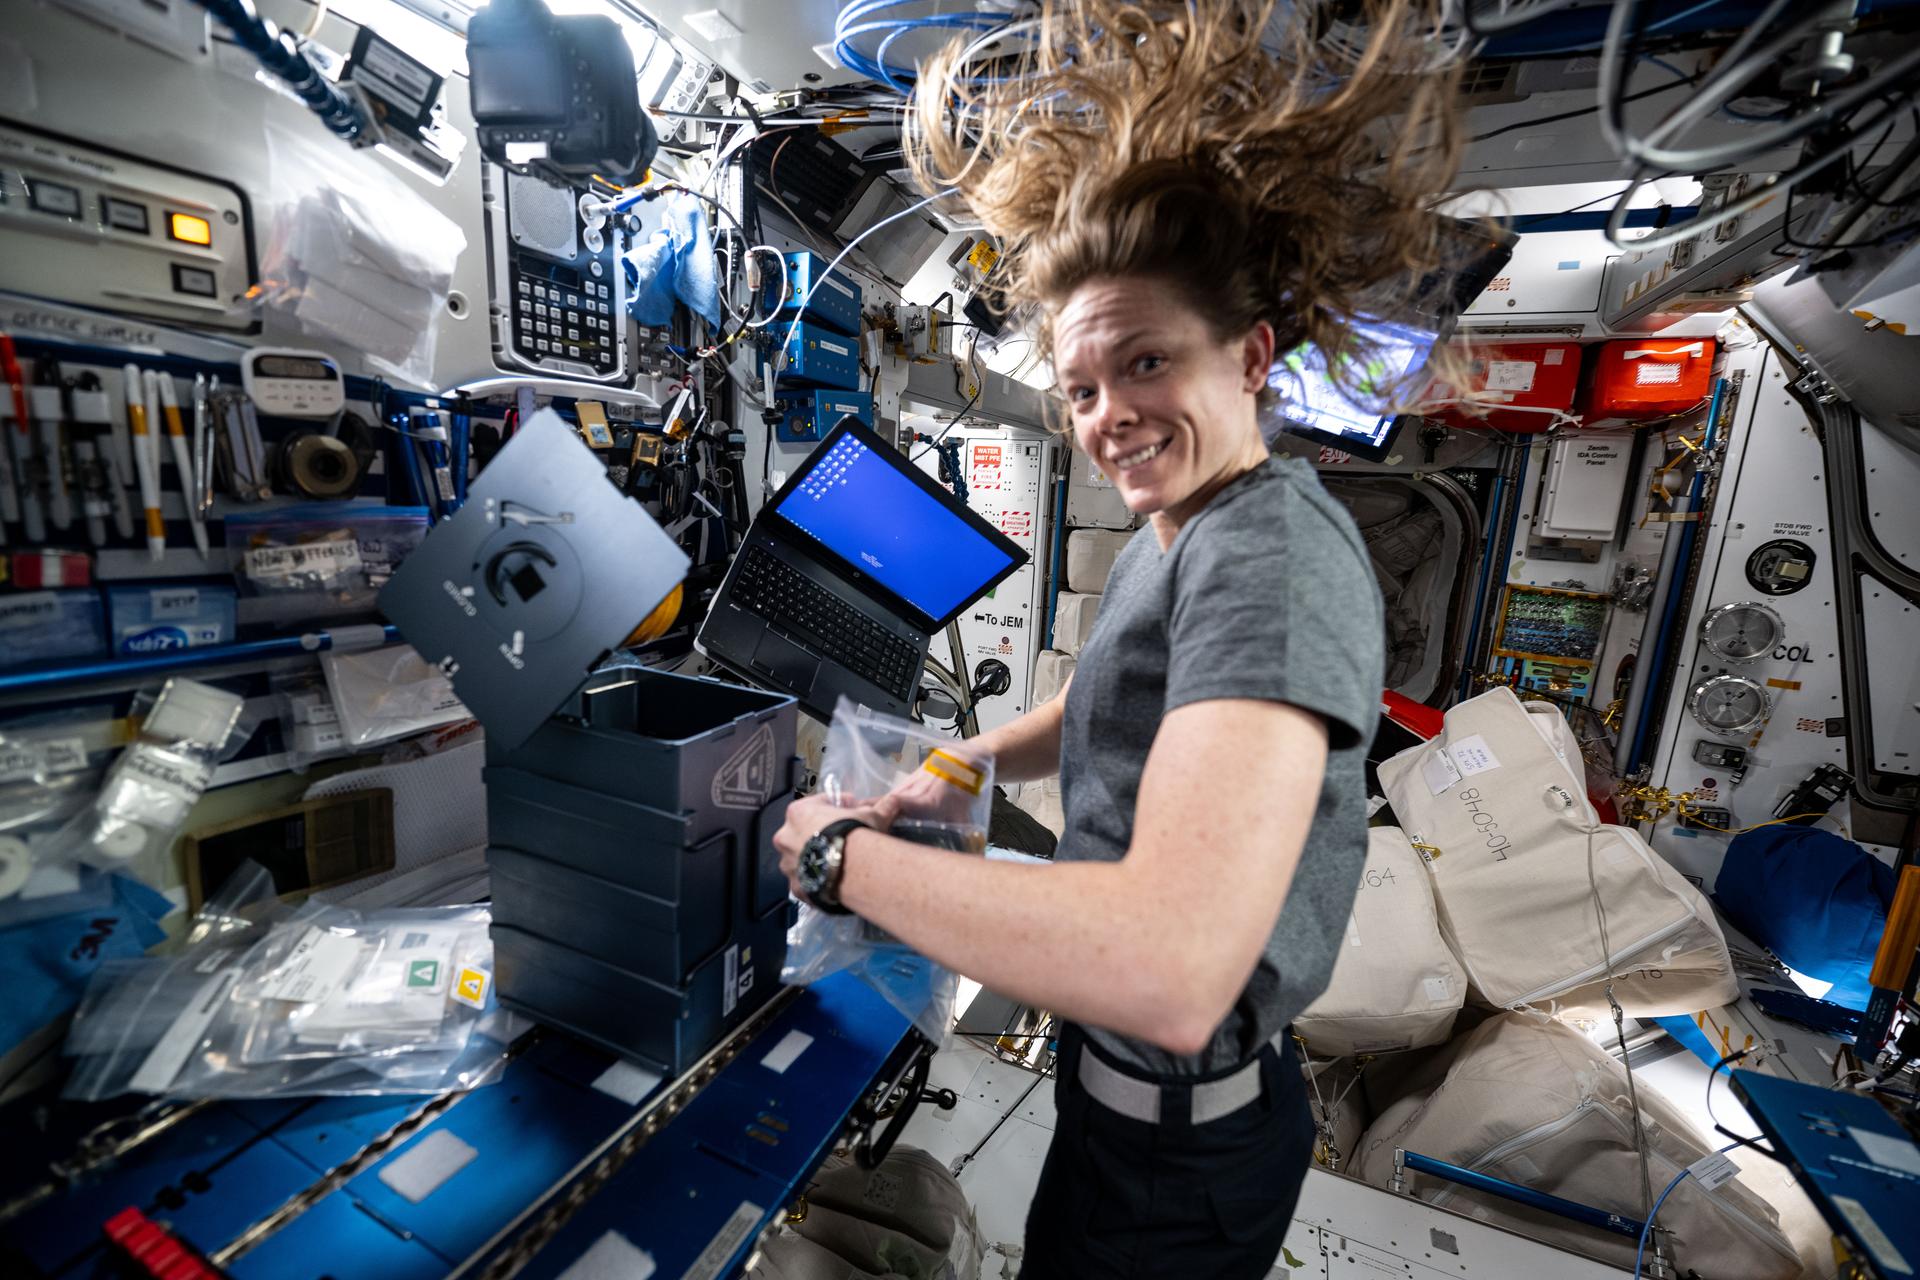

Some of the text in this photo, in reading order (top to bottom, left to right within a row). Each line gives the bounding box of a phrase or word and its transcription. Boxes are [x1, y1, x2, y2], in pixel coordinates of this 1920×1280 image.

[977, 447, 999, 455] WATER
[984, 613, 1023, 629] To JEM
[1772, 644, 1814, 663] COL
